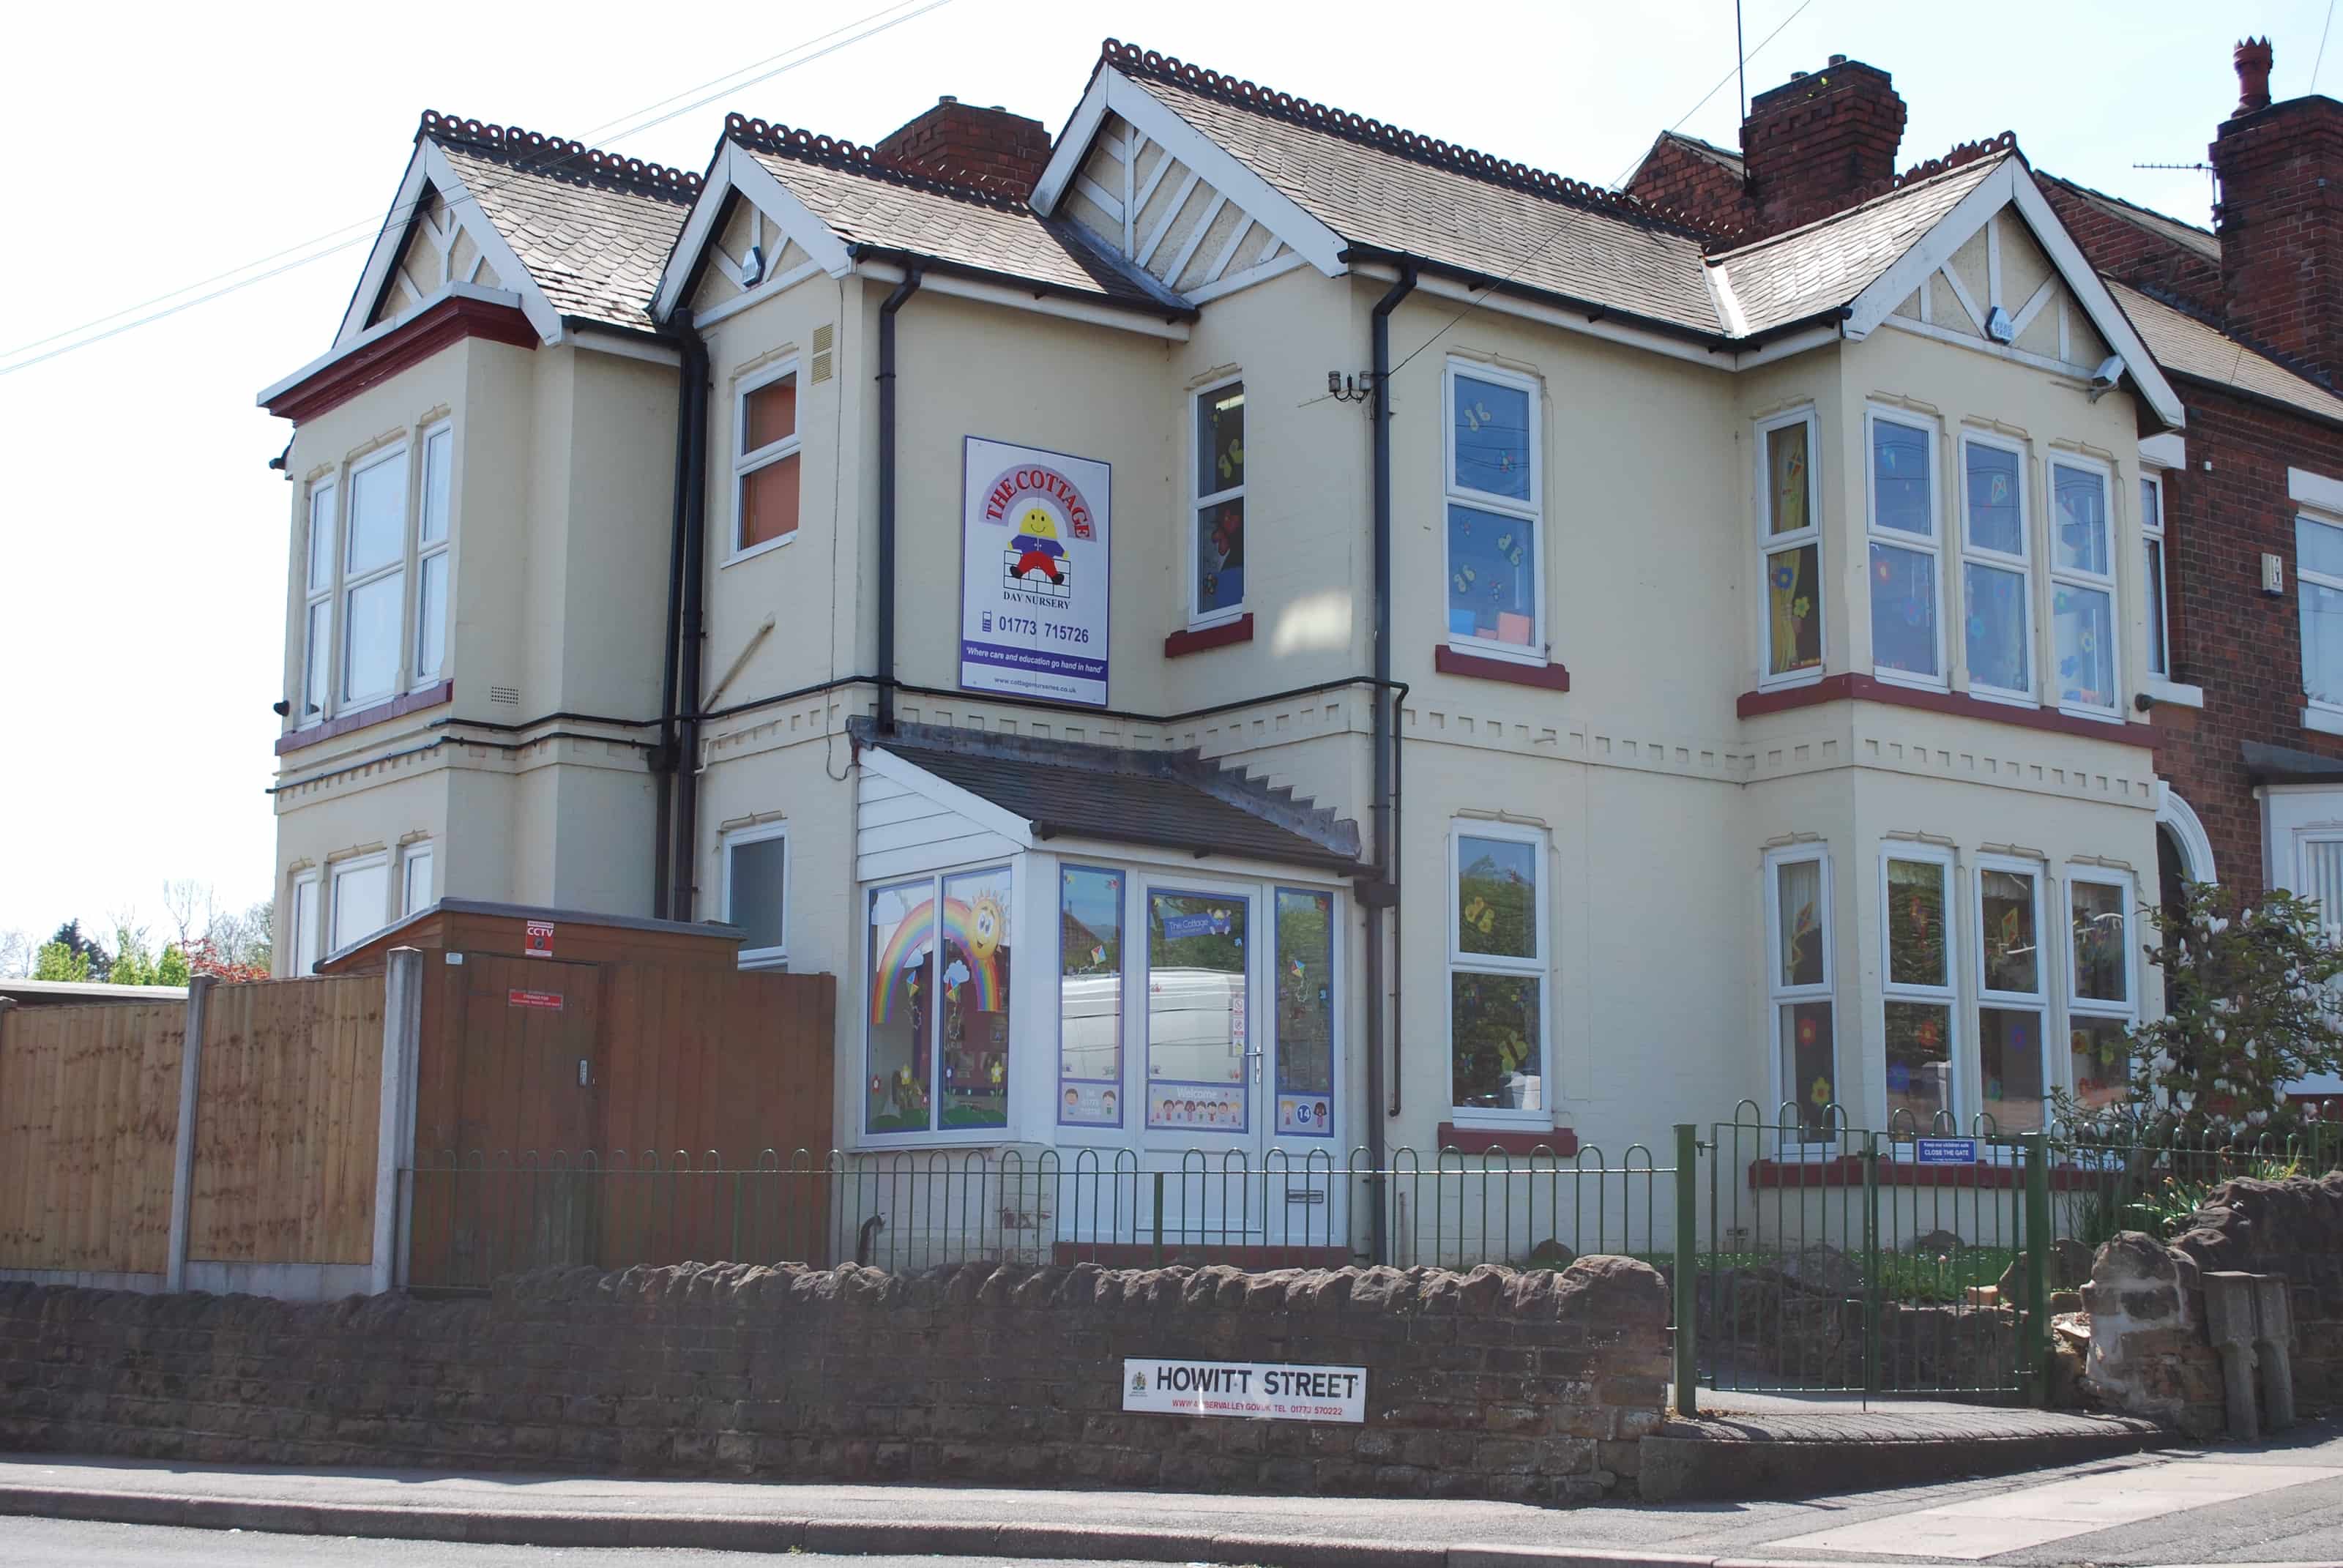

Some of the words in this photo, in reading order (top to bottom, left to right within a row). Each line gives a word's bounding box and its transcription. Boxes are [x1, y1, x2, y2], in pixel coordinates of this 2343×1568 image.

[986, 477, 1018, 520] THE
[1016, 470, 1090, 538] COTTAGE
[1003, 591, 1023, 602] DAY
[1025, 594, 1071, 610] NURSERY
[999, 616, 1037, 635] 01773
[1044, 623, 1089, 643] 715726
[990, 651, 1004, 659] care
[1005, 653, 1018, 662] and
[1018, 654, 1050, 666] education
[1061, 661, 1077, 670] hand
[1078, 662, 1084, 671] in
[527, 927, 554, 937] CCTV
[1177, 1086, 1218, 1100] Welcome
[1299, 1108, 1310, 1119] 14
[1156, 1366, 1252, 1395] HOWITT
[1264, 1370, 1359, 1399] STREET
[1275, 1404, 1286, 1412] TEL
[1290, 1405, 1312, 1414] 01773
[1314, 1405, 1343, 1415] 570222
